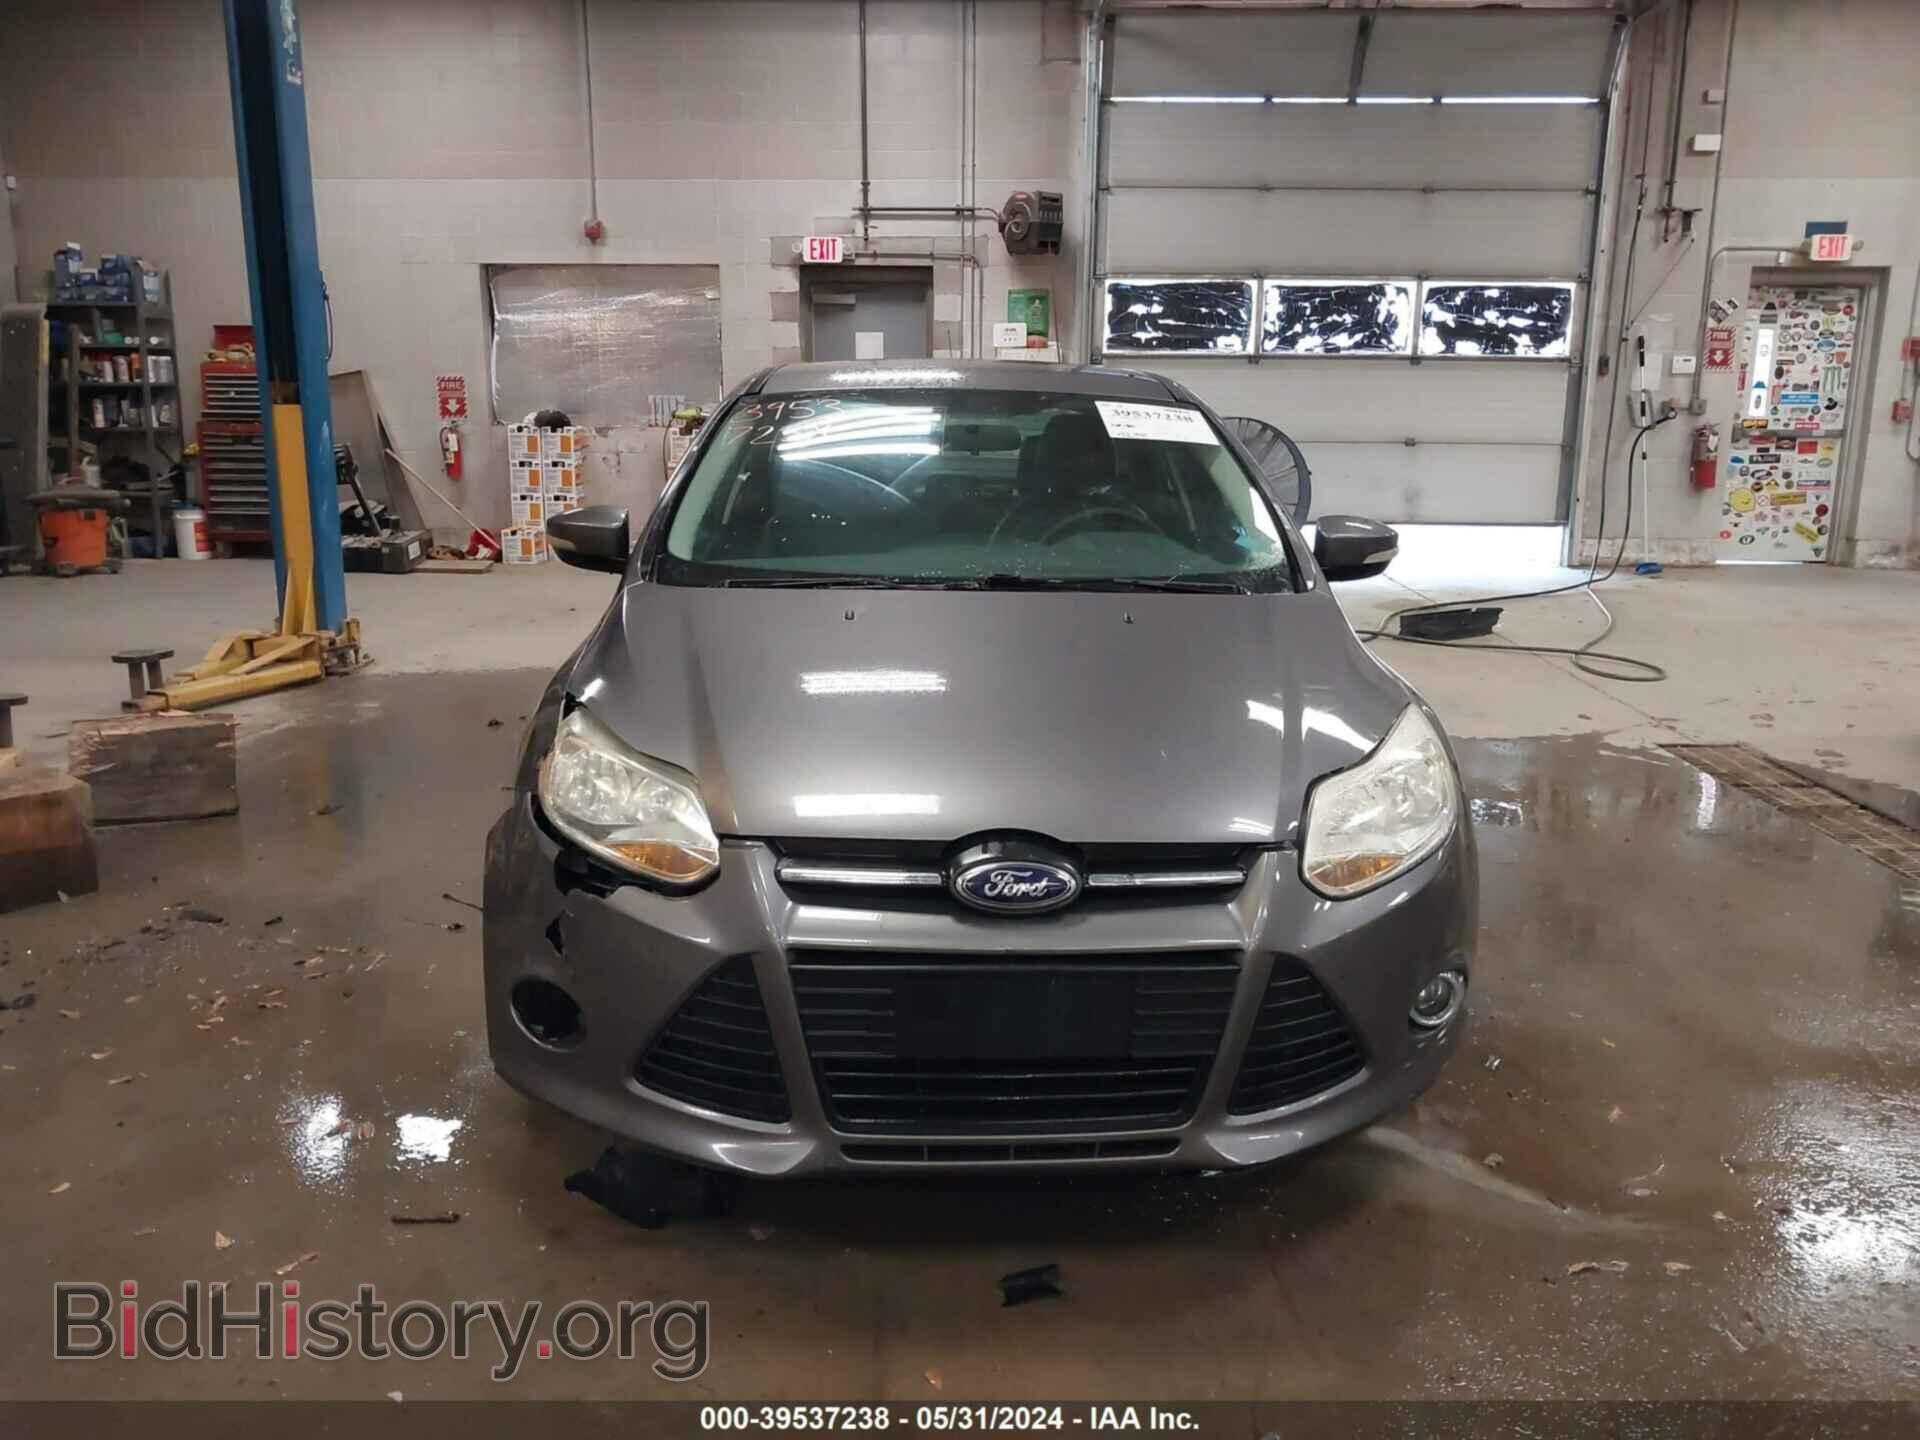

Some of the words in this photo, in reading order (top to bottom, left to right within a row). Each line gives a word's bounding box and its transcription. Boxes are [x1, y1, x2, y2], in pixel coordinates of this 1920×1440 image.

[810, 238, 837, 260] EXIT
[1818, 235, 1848, 258] EXIT
[440, 381, 464, 390] FIRE
[984, 869, 1060, 897] Ford
